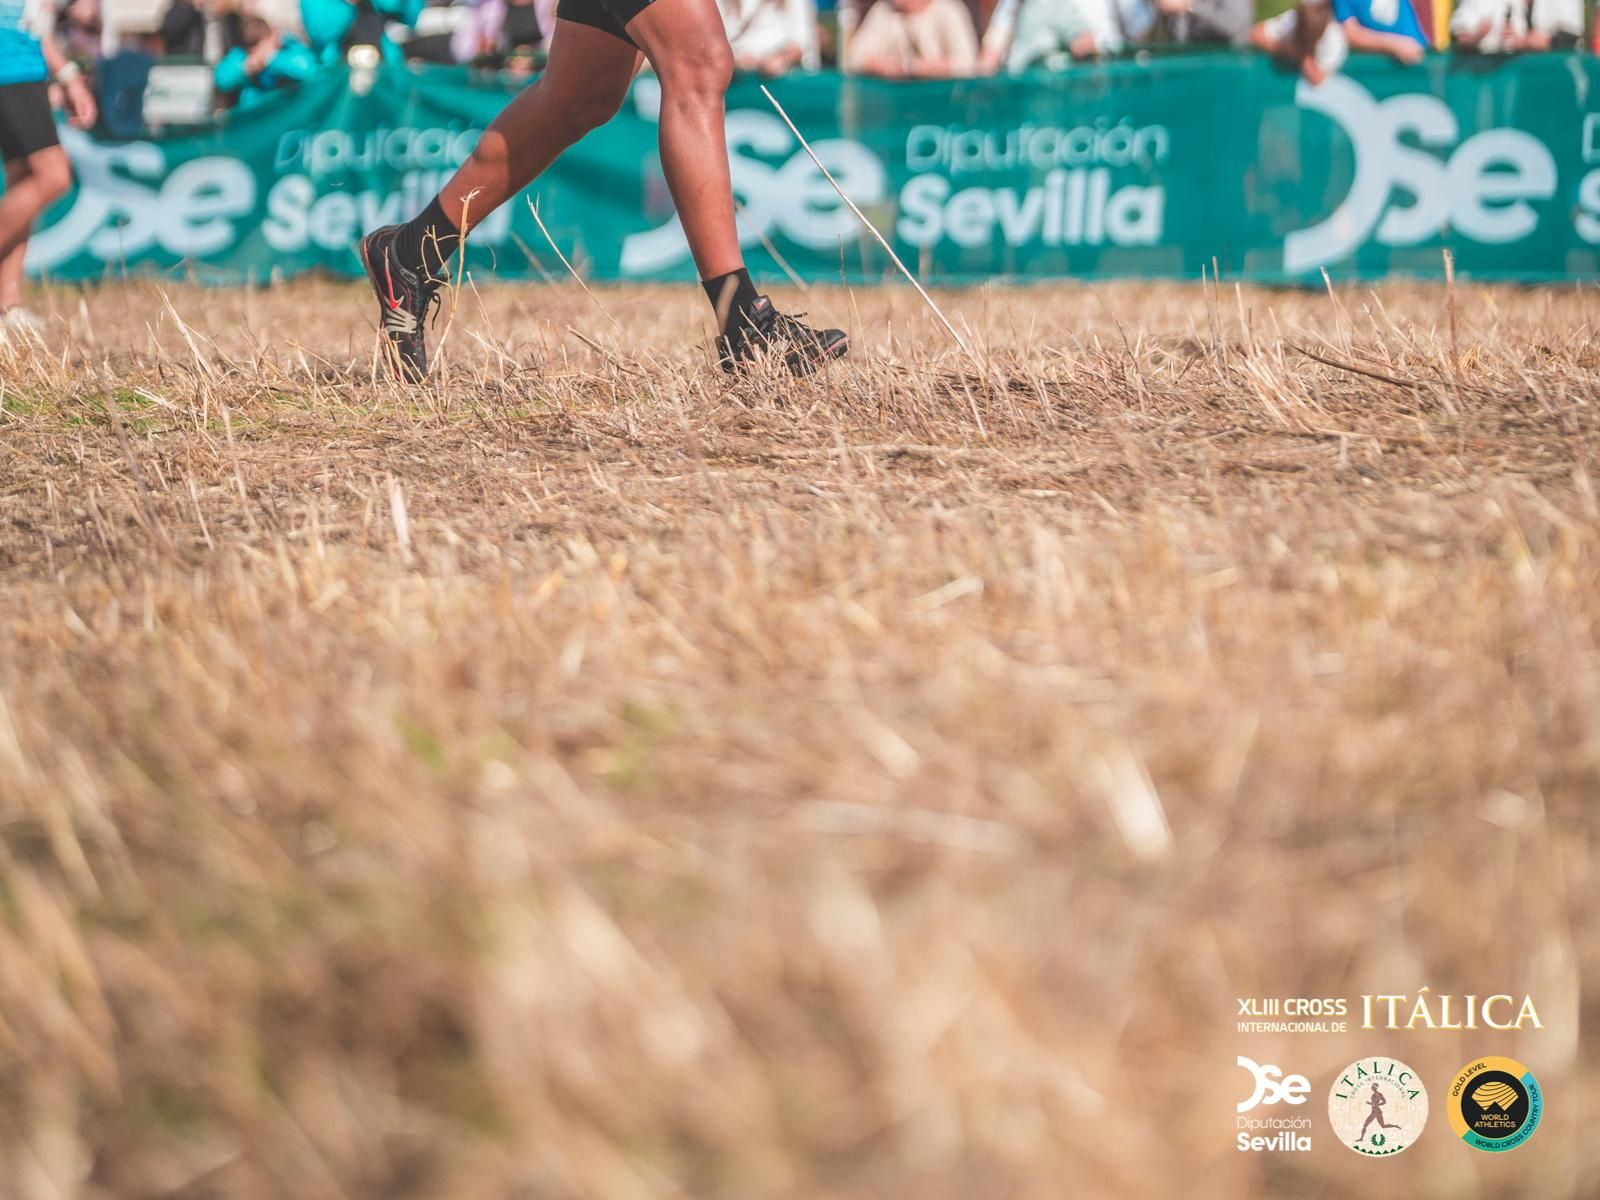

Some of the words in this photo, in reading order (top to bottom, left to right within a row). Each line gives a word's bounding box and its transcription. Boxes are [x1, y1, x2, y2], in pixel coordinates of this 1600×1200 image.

[273, 125, 485, 179] Diputaci
[905, 116, 1171, 179] Diputación
[261, 168, 514, 251] Sevi
[897, 166, 1166, 247] Sevilla
